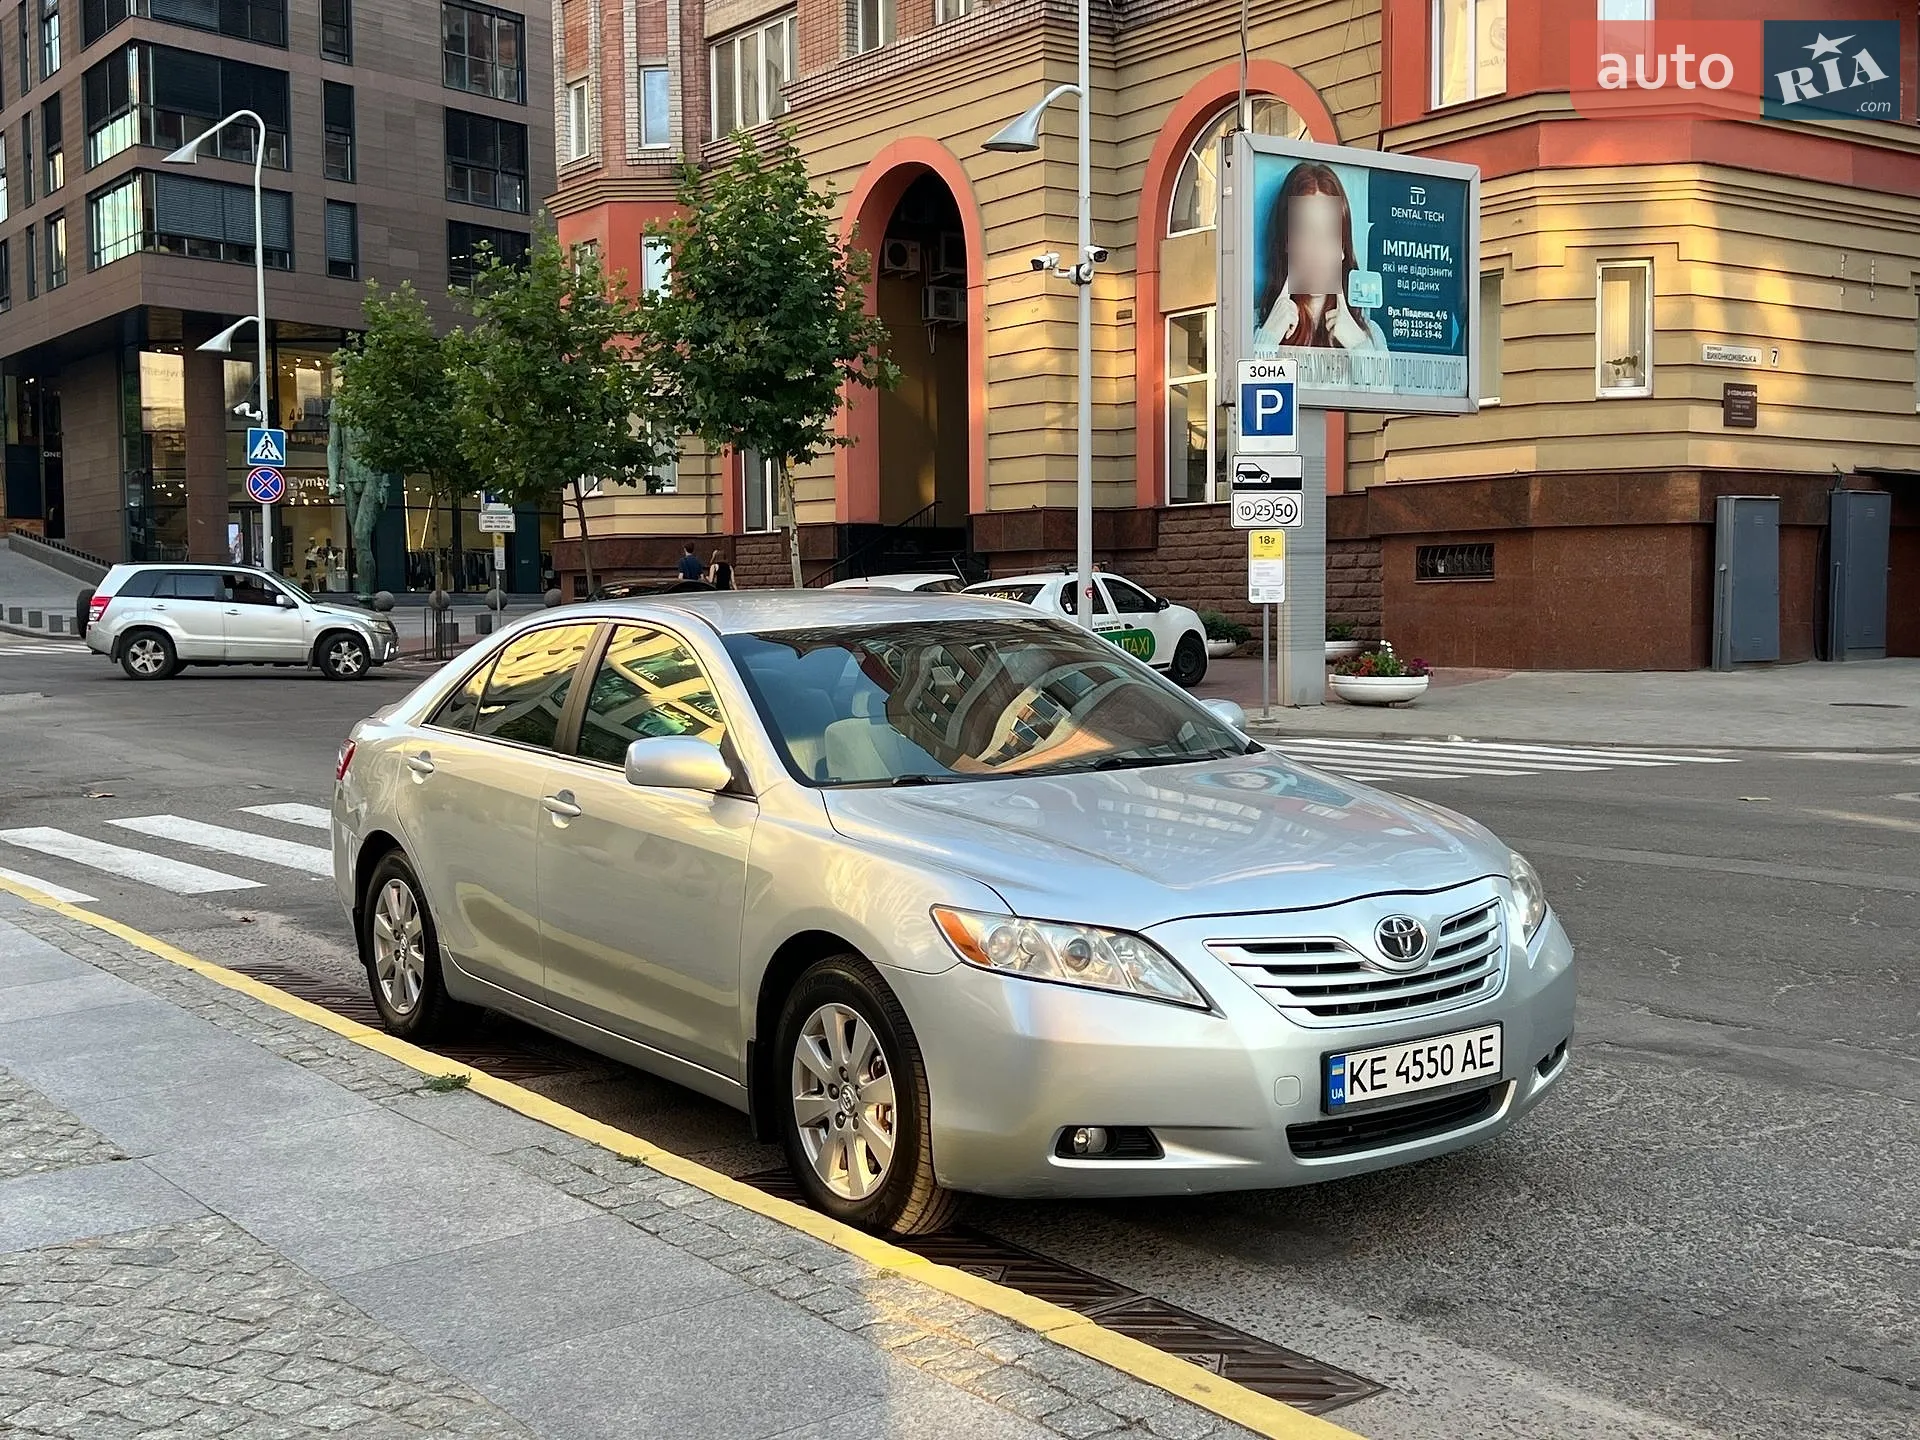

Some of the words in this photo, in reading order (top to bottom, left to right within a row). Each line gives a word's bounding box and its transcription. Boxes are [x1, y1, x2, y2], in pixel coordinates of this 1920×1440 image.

[1391, 207, 1422, 220] DENTAL
[1424, 210, 1445, 222] TECH
[1383, 239, 1453, 264] ІМПЛАНТИ,
[1383, 262, 1395, 273] які
[1397, 264, 1408, 274] не
[1410, 263, 1453, 278] відрізнити
[1397, 277, 1409, 289] від
[1411, 278, 1440, 292] рідних
[1388, 306, 1401, 318] Вул.
[1436, 310, 1448, 320] 4/6
[1392, 327, 1410, 338] (097)
[1772, 351, 1778, 363] 7
[1249, 365, 1286, 378] ЗОНА
[1240, 505, 1251, 516] 10
[1256, 504, 1271, 517] 25
[1274, 503, 1293, 518] 50
[1349, 1055, 1387, 1095] KE
[1395, 1044, 1454, 1084] 4550
[1460, 1034, 1494, 1073] AE
[1331, 1088, 1344, 1100] UA
